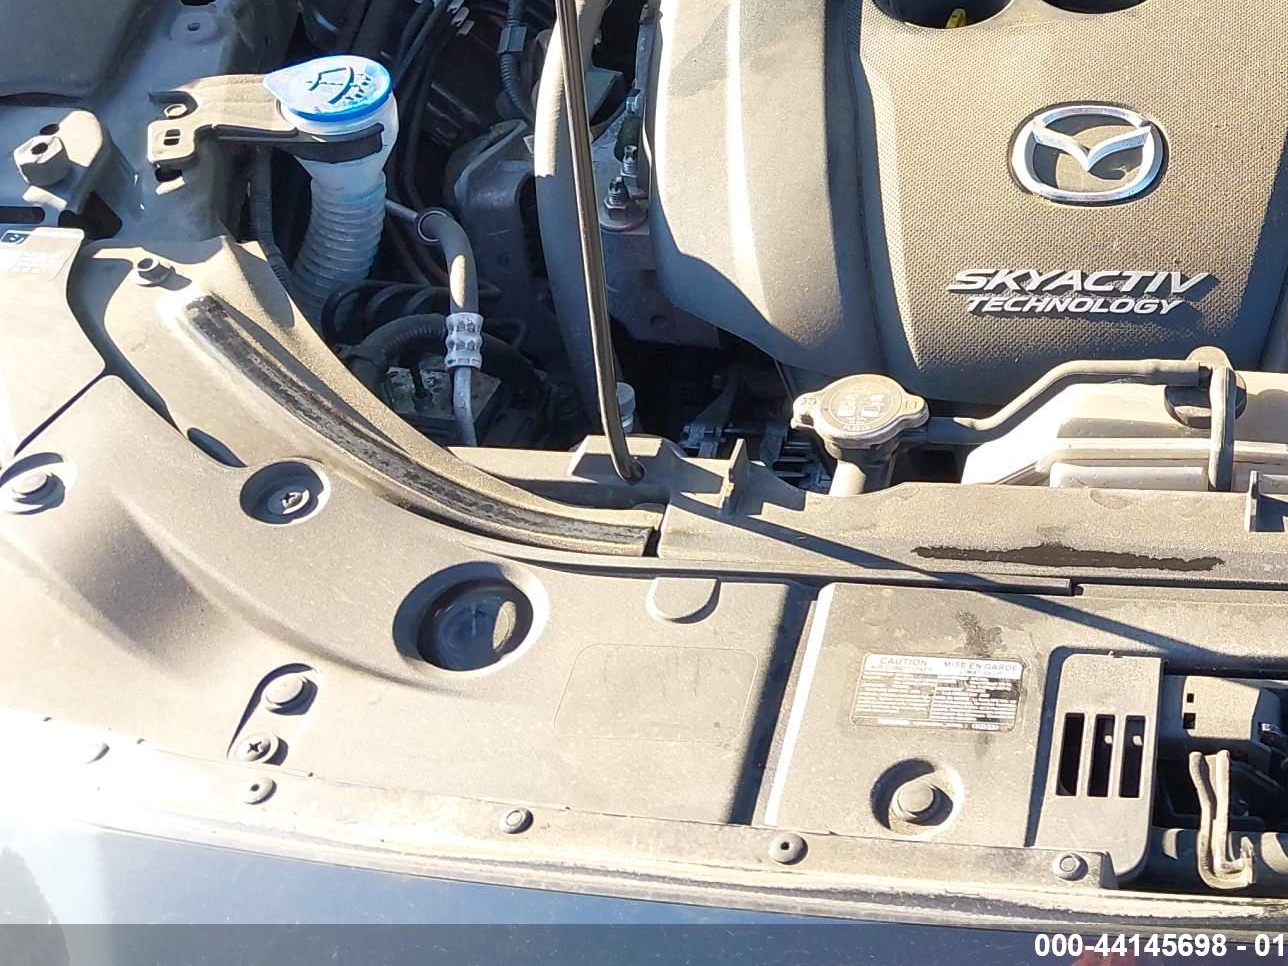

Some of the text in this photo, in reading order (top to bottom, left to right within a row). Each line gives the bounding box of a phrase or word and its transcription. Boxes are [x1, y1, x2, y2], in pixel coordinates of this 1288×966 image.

[948, 269, 1208, 294] SKYACTIV
[966, 296, 1185, 315] TECHNOLOGY
[879, 657, 928, 667] CAUTION
[943, 660, 1018, 672] MISE EN GARDE
